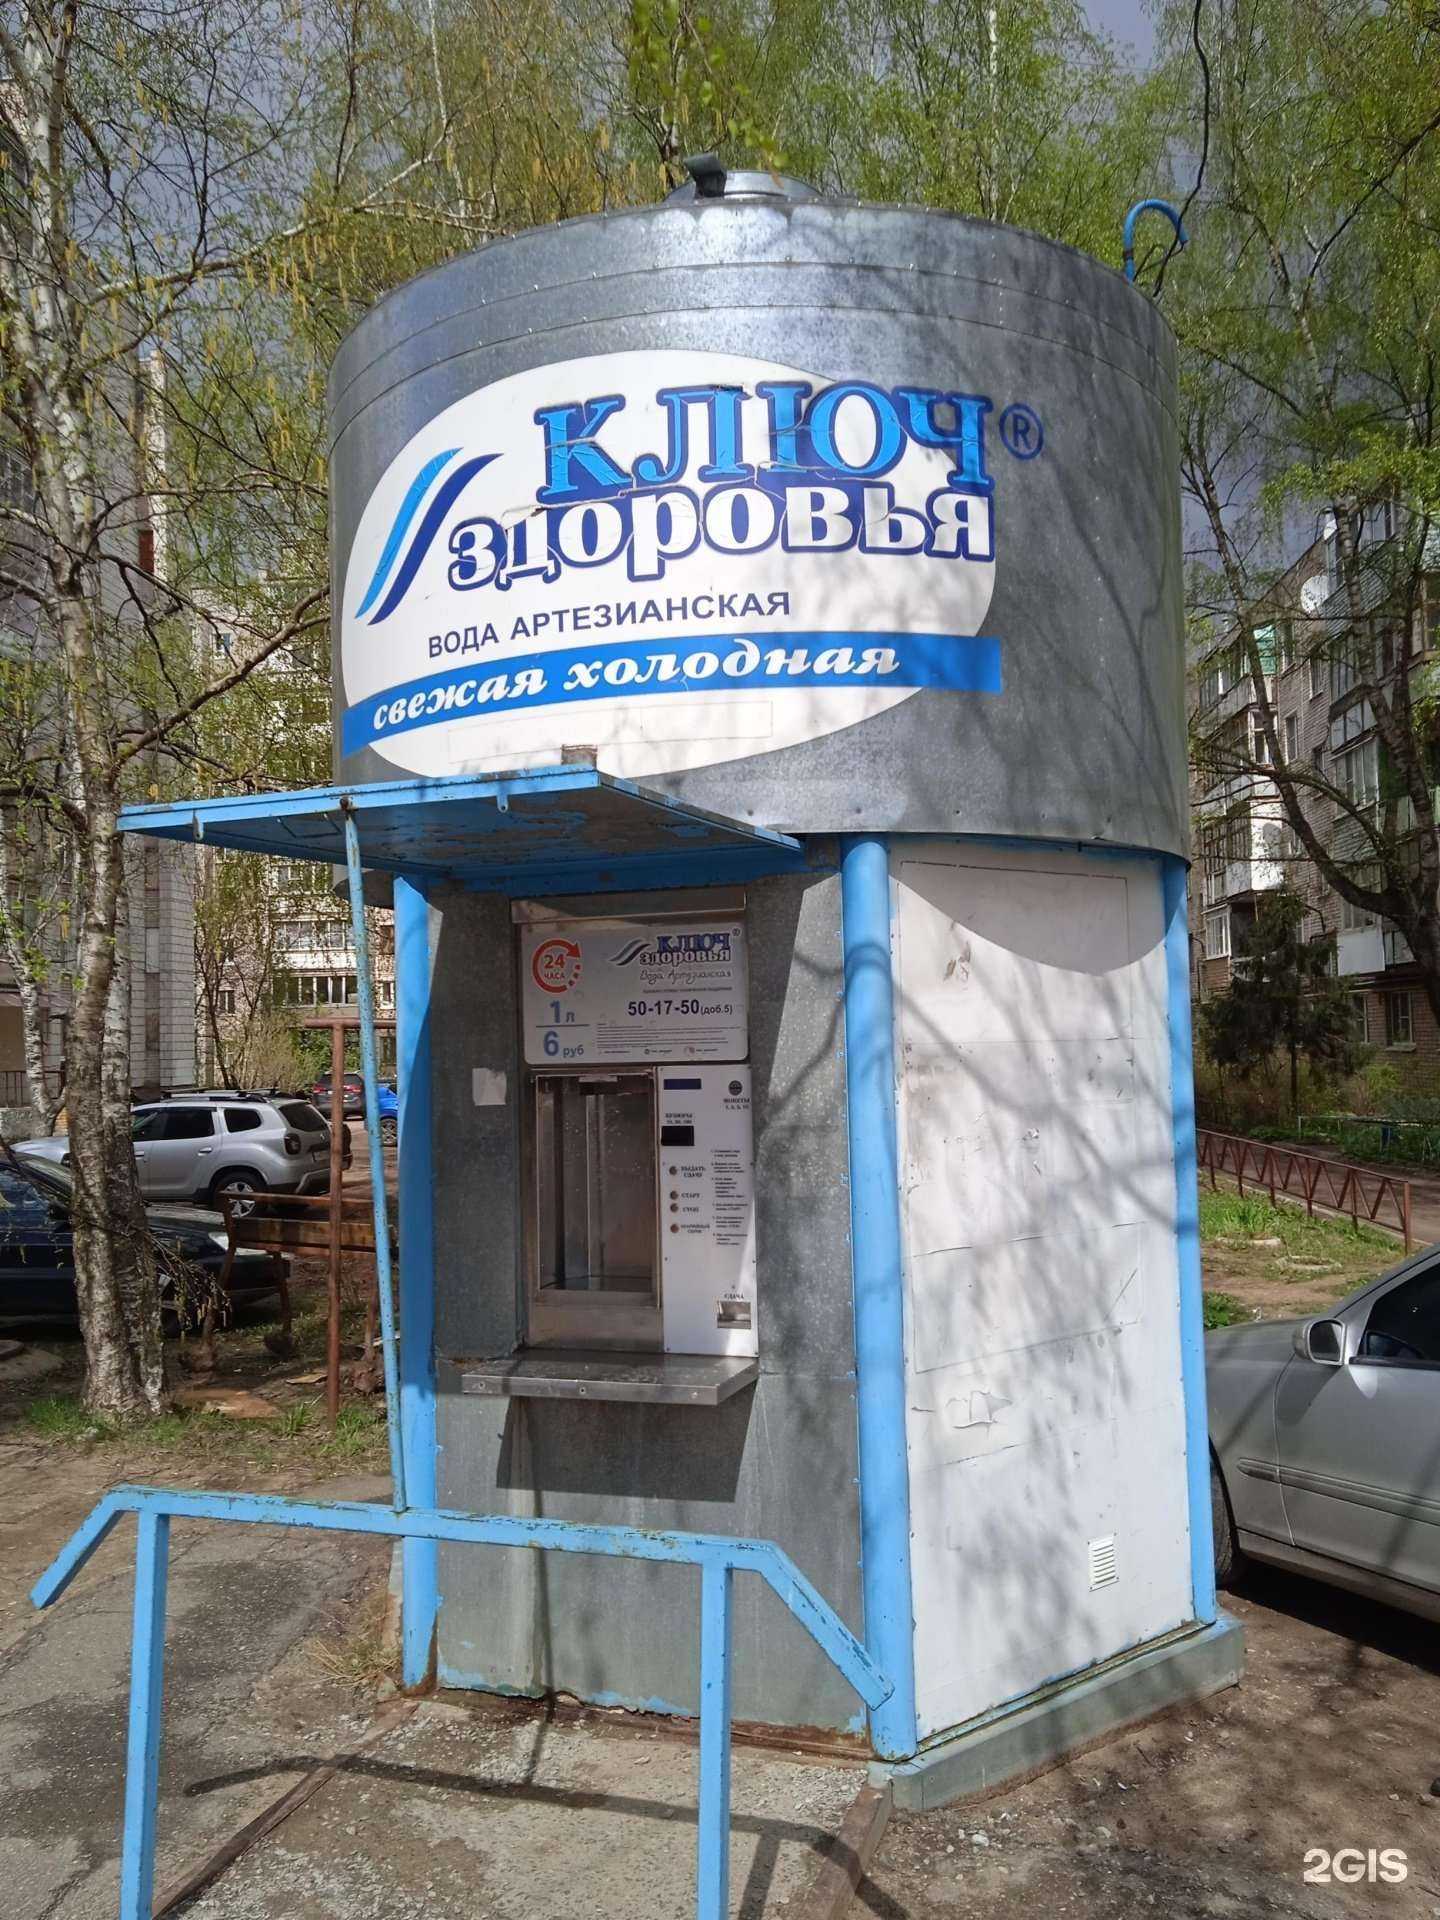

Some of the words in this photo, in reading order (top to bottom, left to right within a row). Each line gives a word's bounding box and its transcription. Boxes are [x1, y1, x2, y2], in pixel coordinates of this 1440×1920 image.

[533, 381, 995, 504] КЛЮЧ
[428, 623, 499, 658] ВОДА
[510, 592, 790, 640] АРТЕЗИАНСКАЯ
[373, 666, 547, 731] свежая
[563, 638, 899, 689] холодная
[543, 954, 565, 969] 24
[549, 1000, 561, 1023] 1
[628, 999, 700, 1016] 50-17-50
[543, 1031, 560, 1056] 6
[562, 1044, 585, 1058] руб
